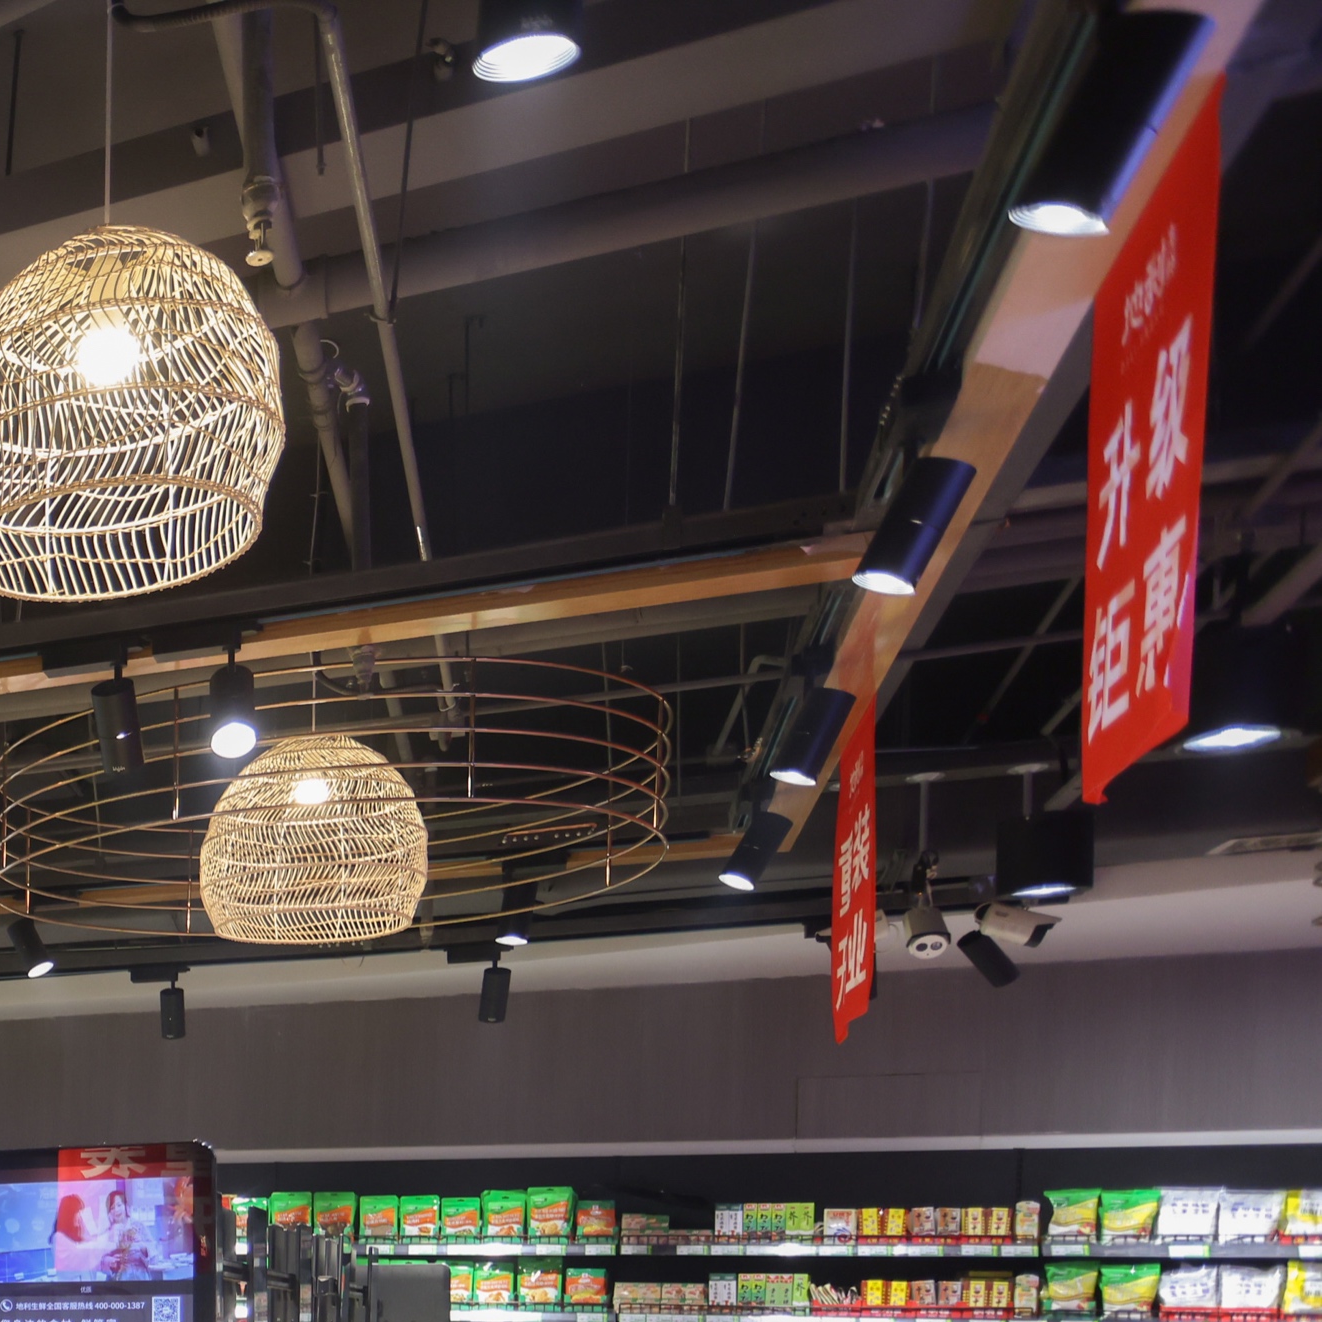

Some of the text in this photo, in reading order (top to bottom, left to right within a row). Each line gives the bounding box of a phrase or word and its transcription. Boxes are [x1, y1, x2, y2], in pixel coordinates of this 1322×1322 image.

[1097, 313, 1193, 570] 升级
[838, 803, 871, 918] 重装
[94, 1301, 145, 1310] 400-000-1387
